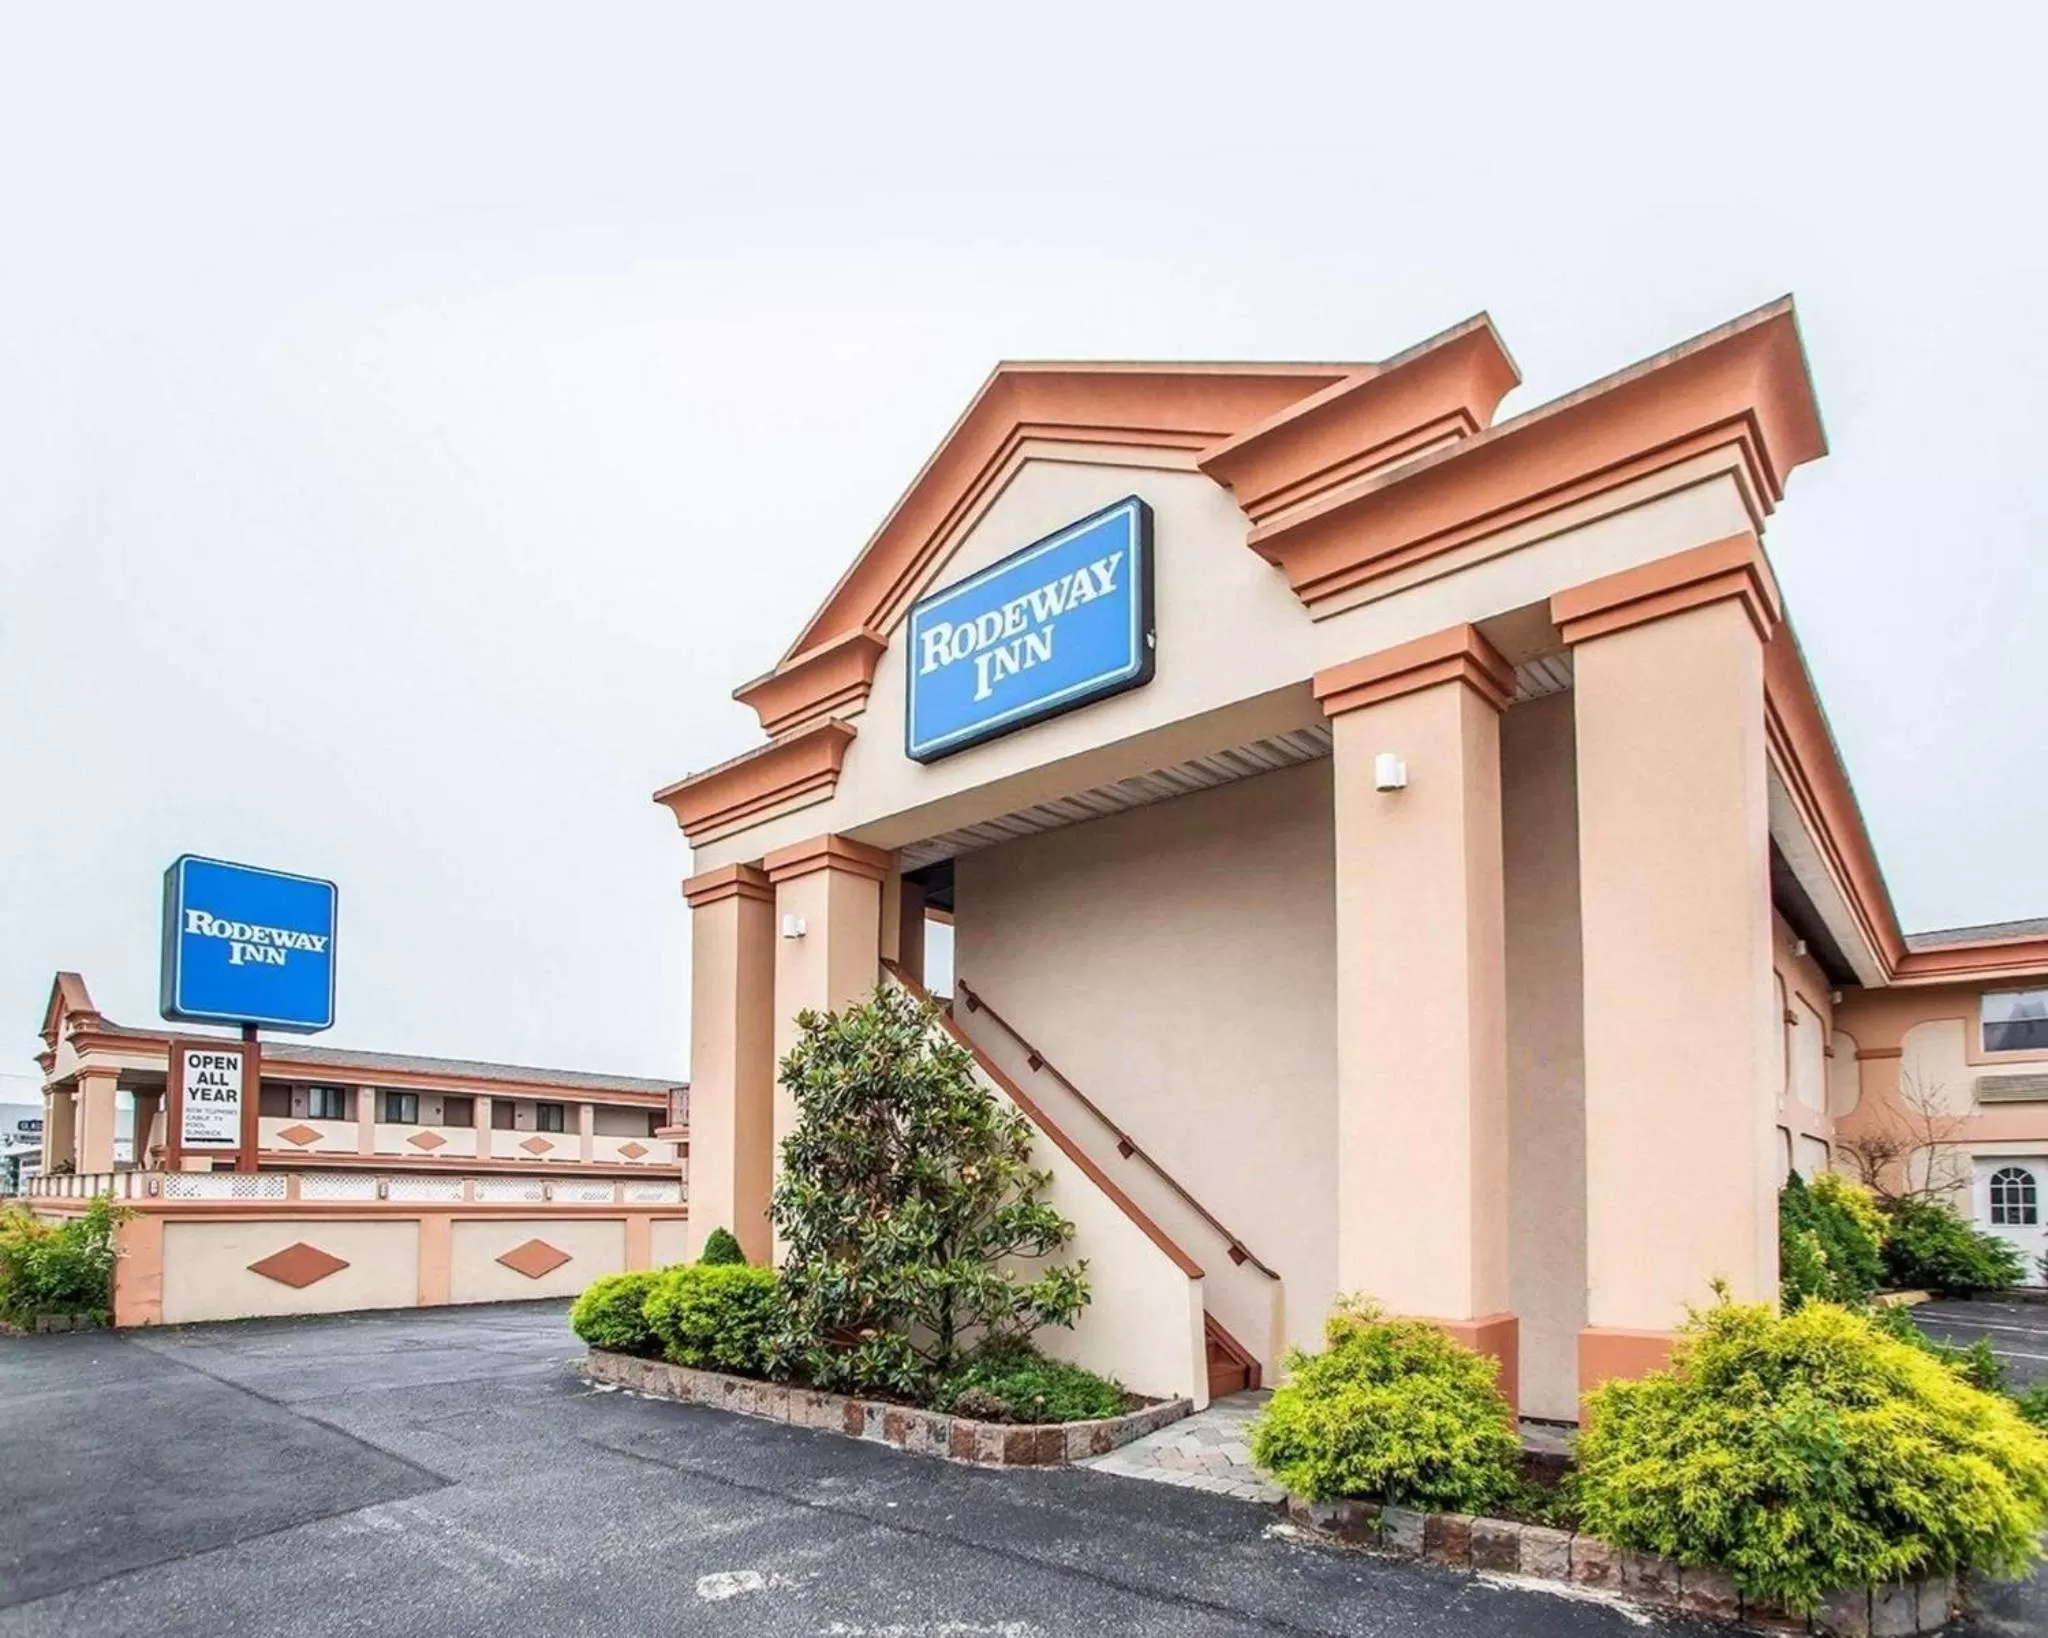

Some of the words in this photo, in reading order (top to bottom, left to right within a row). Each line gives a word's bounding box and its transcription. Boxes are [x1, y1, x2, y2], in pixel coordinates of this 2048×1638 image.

[920, 553, 1122, 676] RODEWAY
[972, 624, 1056, 702] INN
[185, 909, 328, 953] RODEWAY
[229, 941, 286, 965] INN
[189, 1054, 237, 1070] OPEN
[196, 1071, 229, 1086] ALL
[188, 1087, 237, 1102] YEAR
